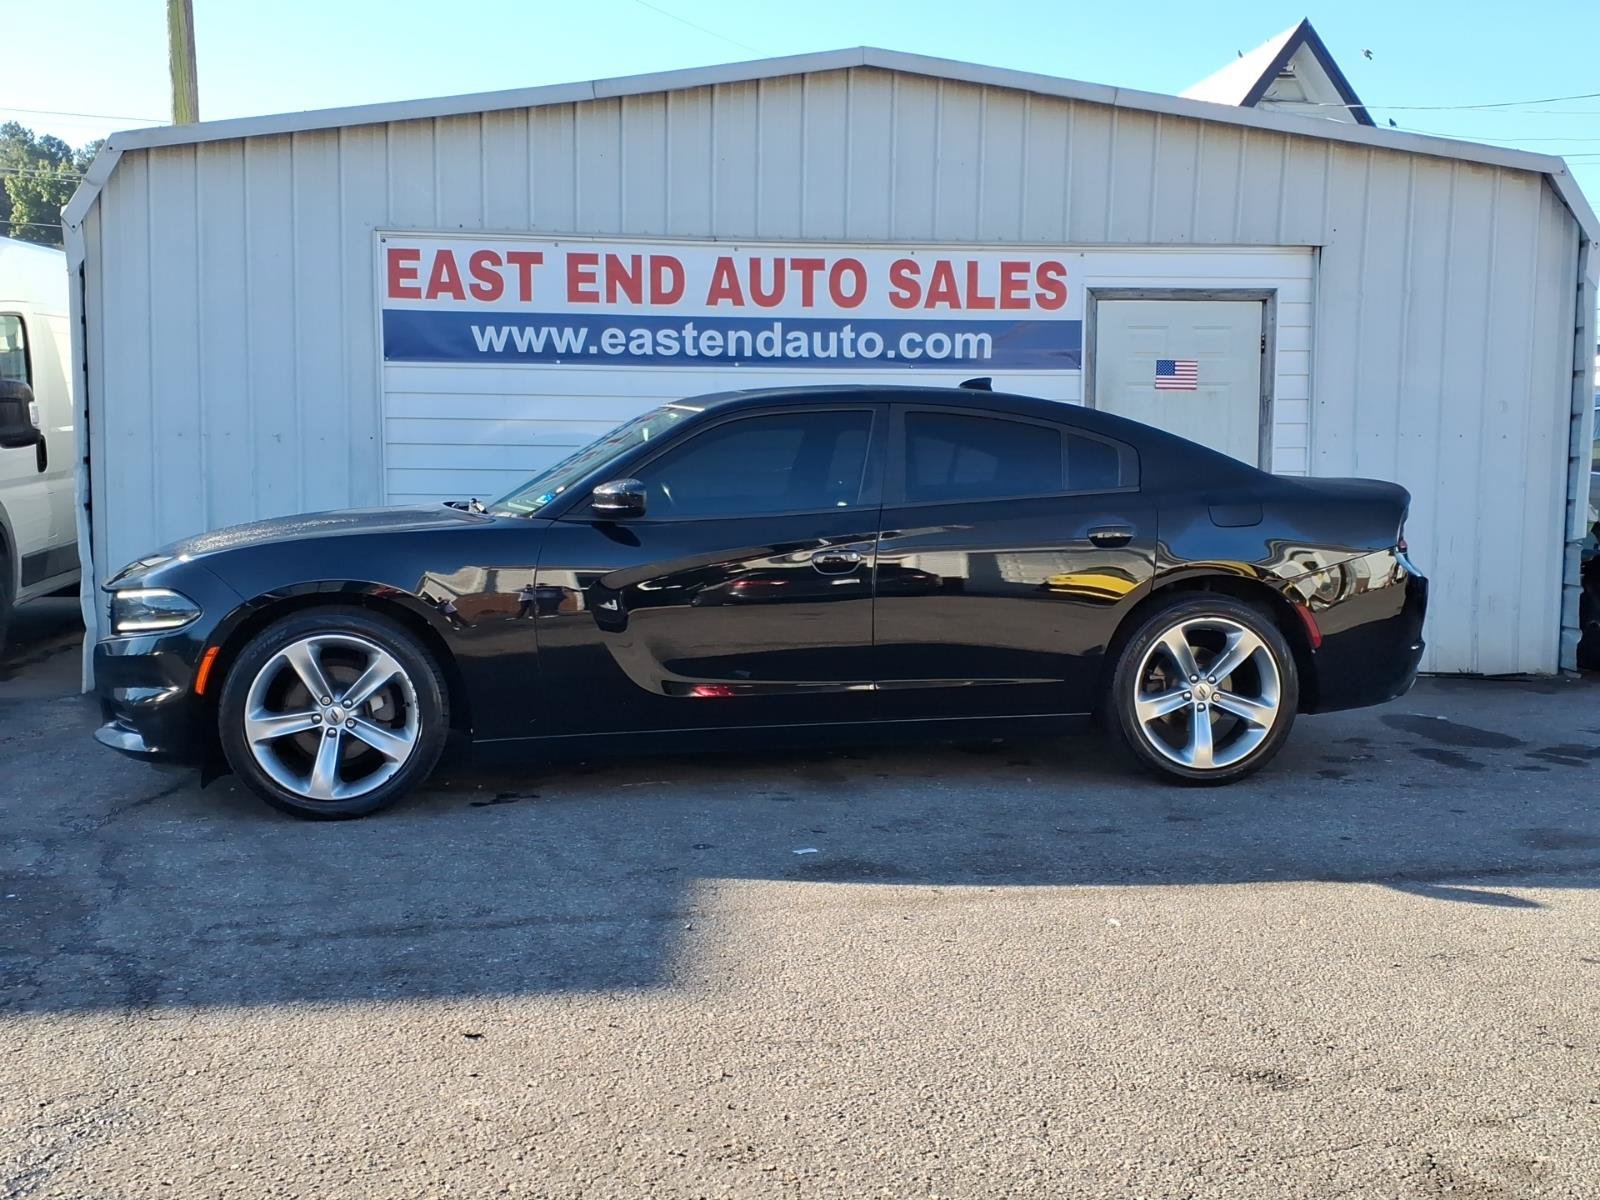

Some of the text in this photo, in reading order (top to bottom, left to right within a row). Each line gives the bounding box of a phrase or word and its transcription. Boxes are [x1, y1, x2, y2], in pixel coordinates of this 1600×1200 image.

[387, 249, 1068, 310] EAST END AUTO SALES
[470, 321, 993, 359] www.eastendauto.com
